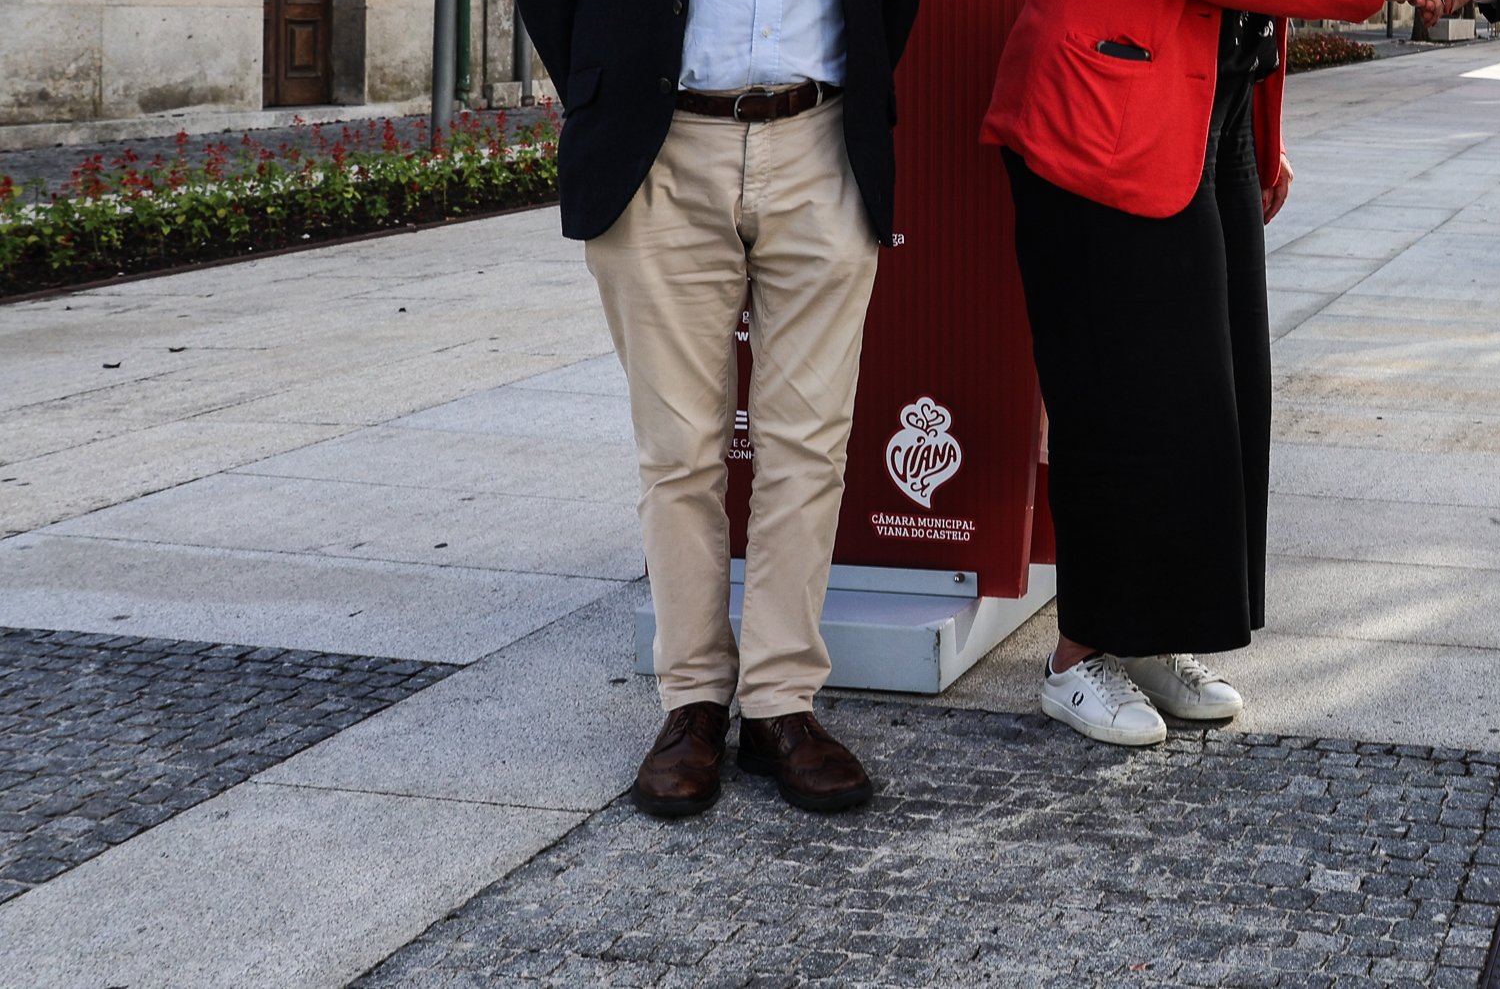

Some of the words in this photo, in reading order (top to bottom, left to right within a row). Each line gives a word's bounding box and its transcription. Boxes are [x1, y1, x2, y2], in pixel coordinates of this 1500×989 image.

[890, 437, 958, 484] VIANA
[871, 512, 916, 527] CÂMARA
[917, 517, 976, 531] MUNICIPAL
[876, 525, 910, 538] VIANA
[911, 529, 925, 539] DO
[926, 529, 971, 542] CASTELO
